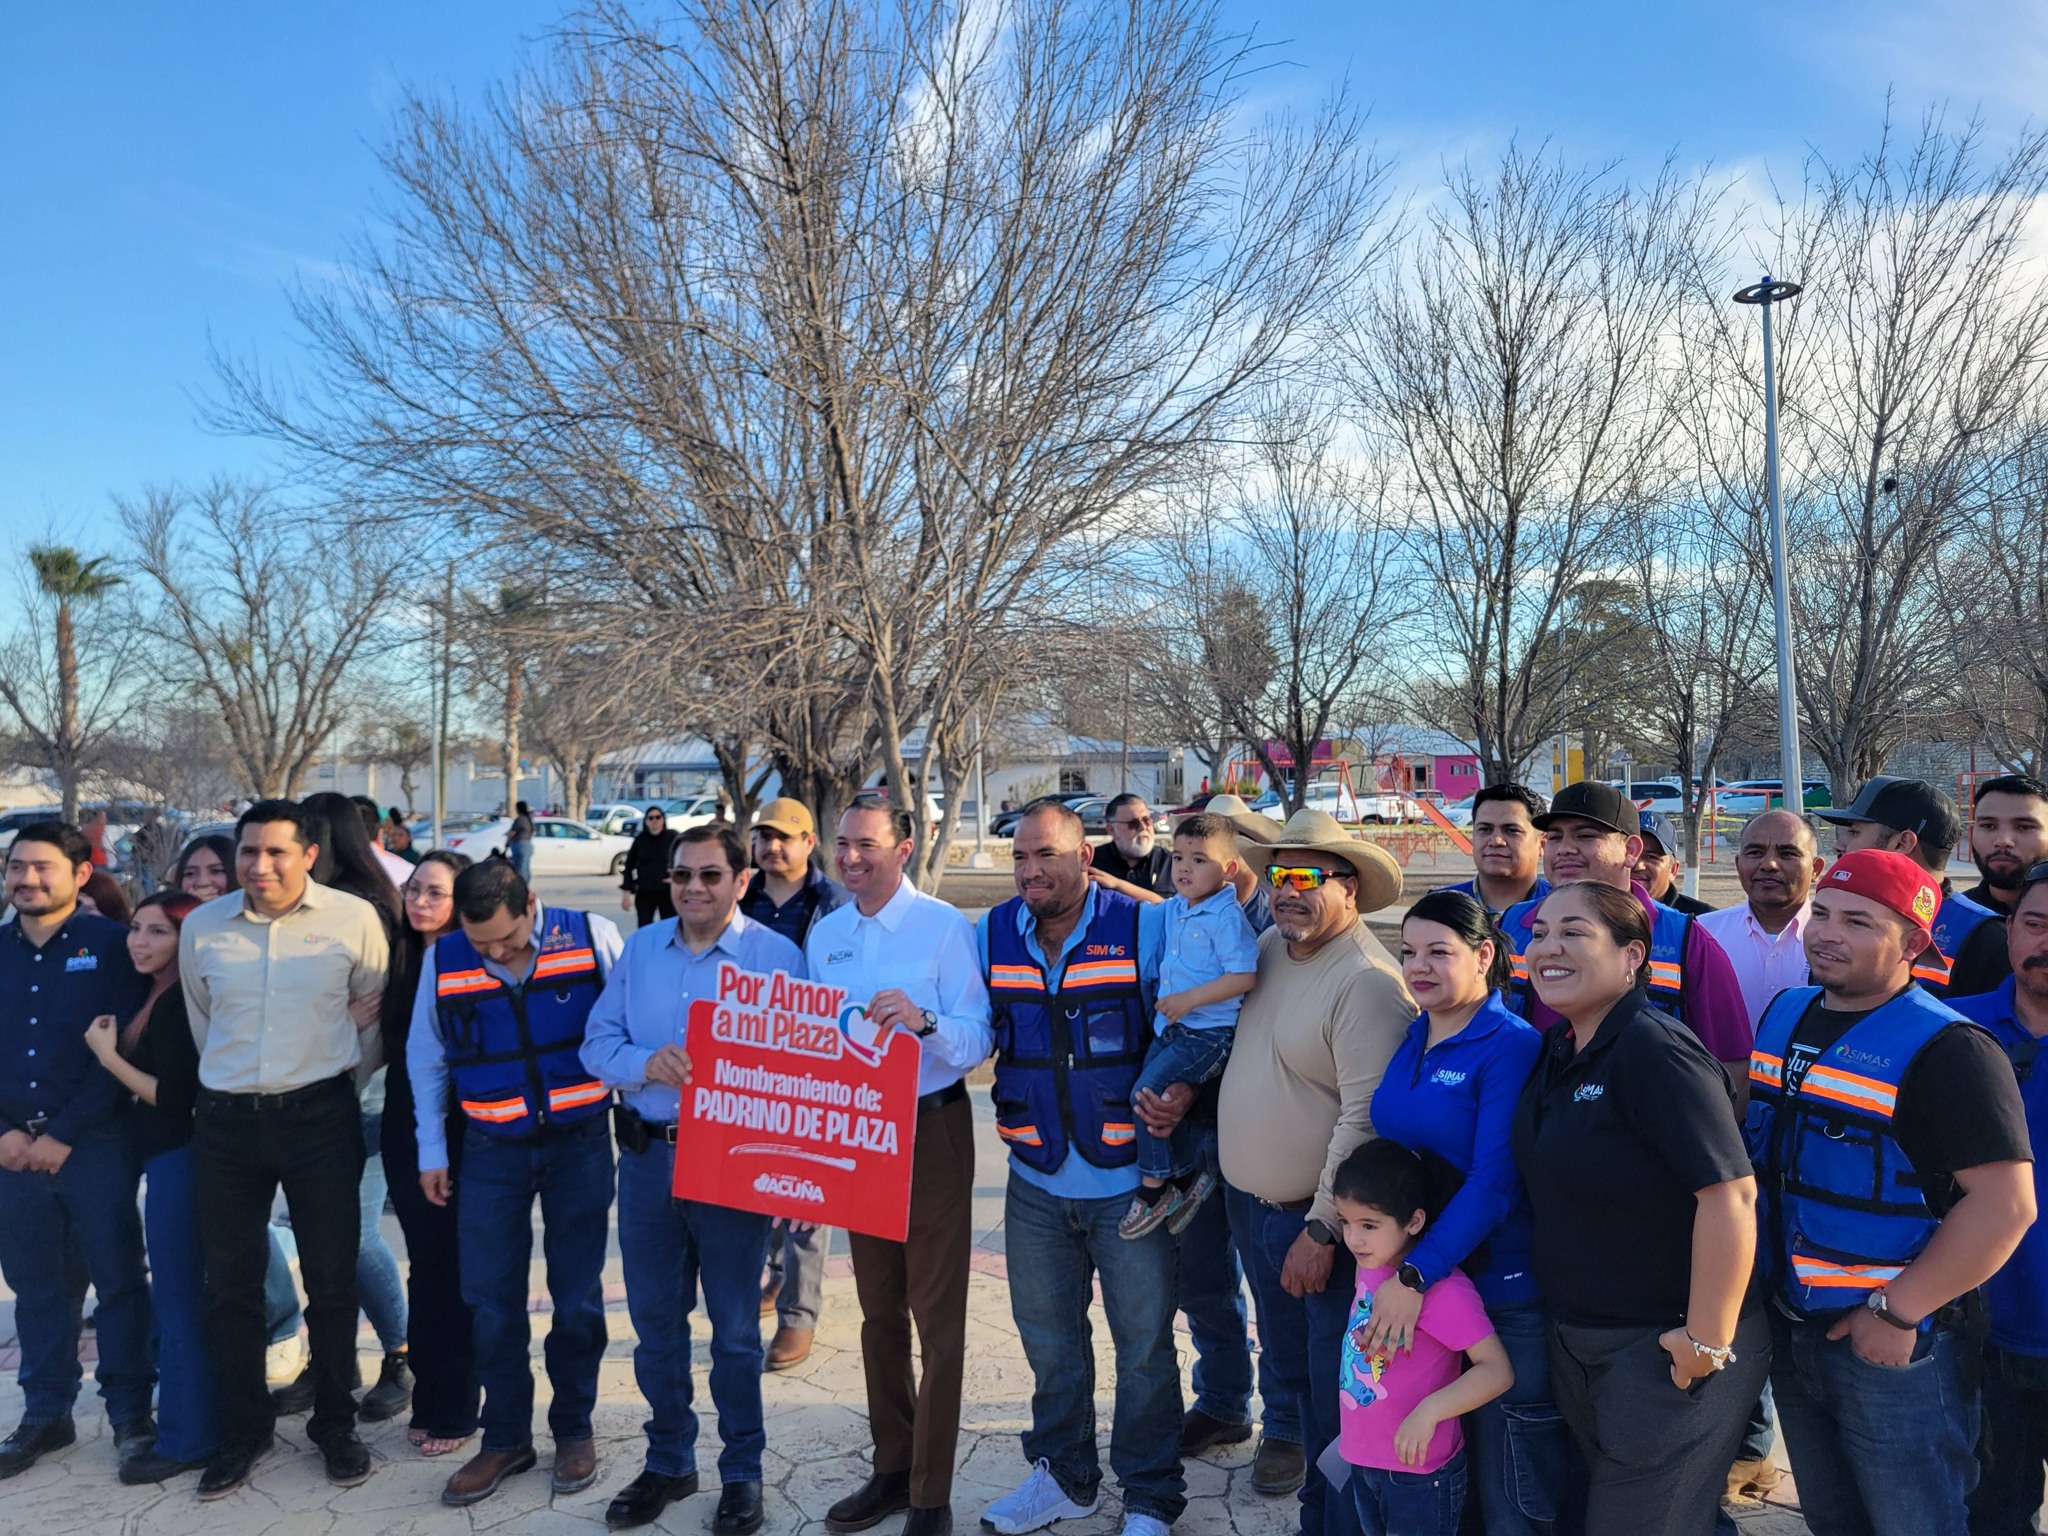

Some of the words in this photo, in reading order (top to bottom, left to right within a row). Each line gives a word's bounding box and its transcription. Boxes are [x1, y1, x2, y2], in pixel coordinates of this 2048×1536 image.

[1651, 944, 1676, 955] MAS
[1930, 932, 1953, 944] MAS
[719, 964, 766, 1007] Por
[768, 972, 845, 1020] Amor
[716, 1008, 732, 1038] a
[736, 1008, 769, 1044] mi
[772, 1012, 839, 1056] Plaza
[1847, 1049, 1893, 1069] SIMAS
[713, 1057, 852, 1108] Nombramiento
[853, 1081, 884, 1113] de:
[1437, 1069, 1467, 1081] SIMAS
[693, 1086, 792, 1135] PADRINO
[793, 1103, 825, 1141] DE
[824, 1109, 900, 1156] PLAZA
[766, 1177, 826, 1204] ACUÑA
